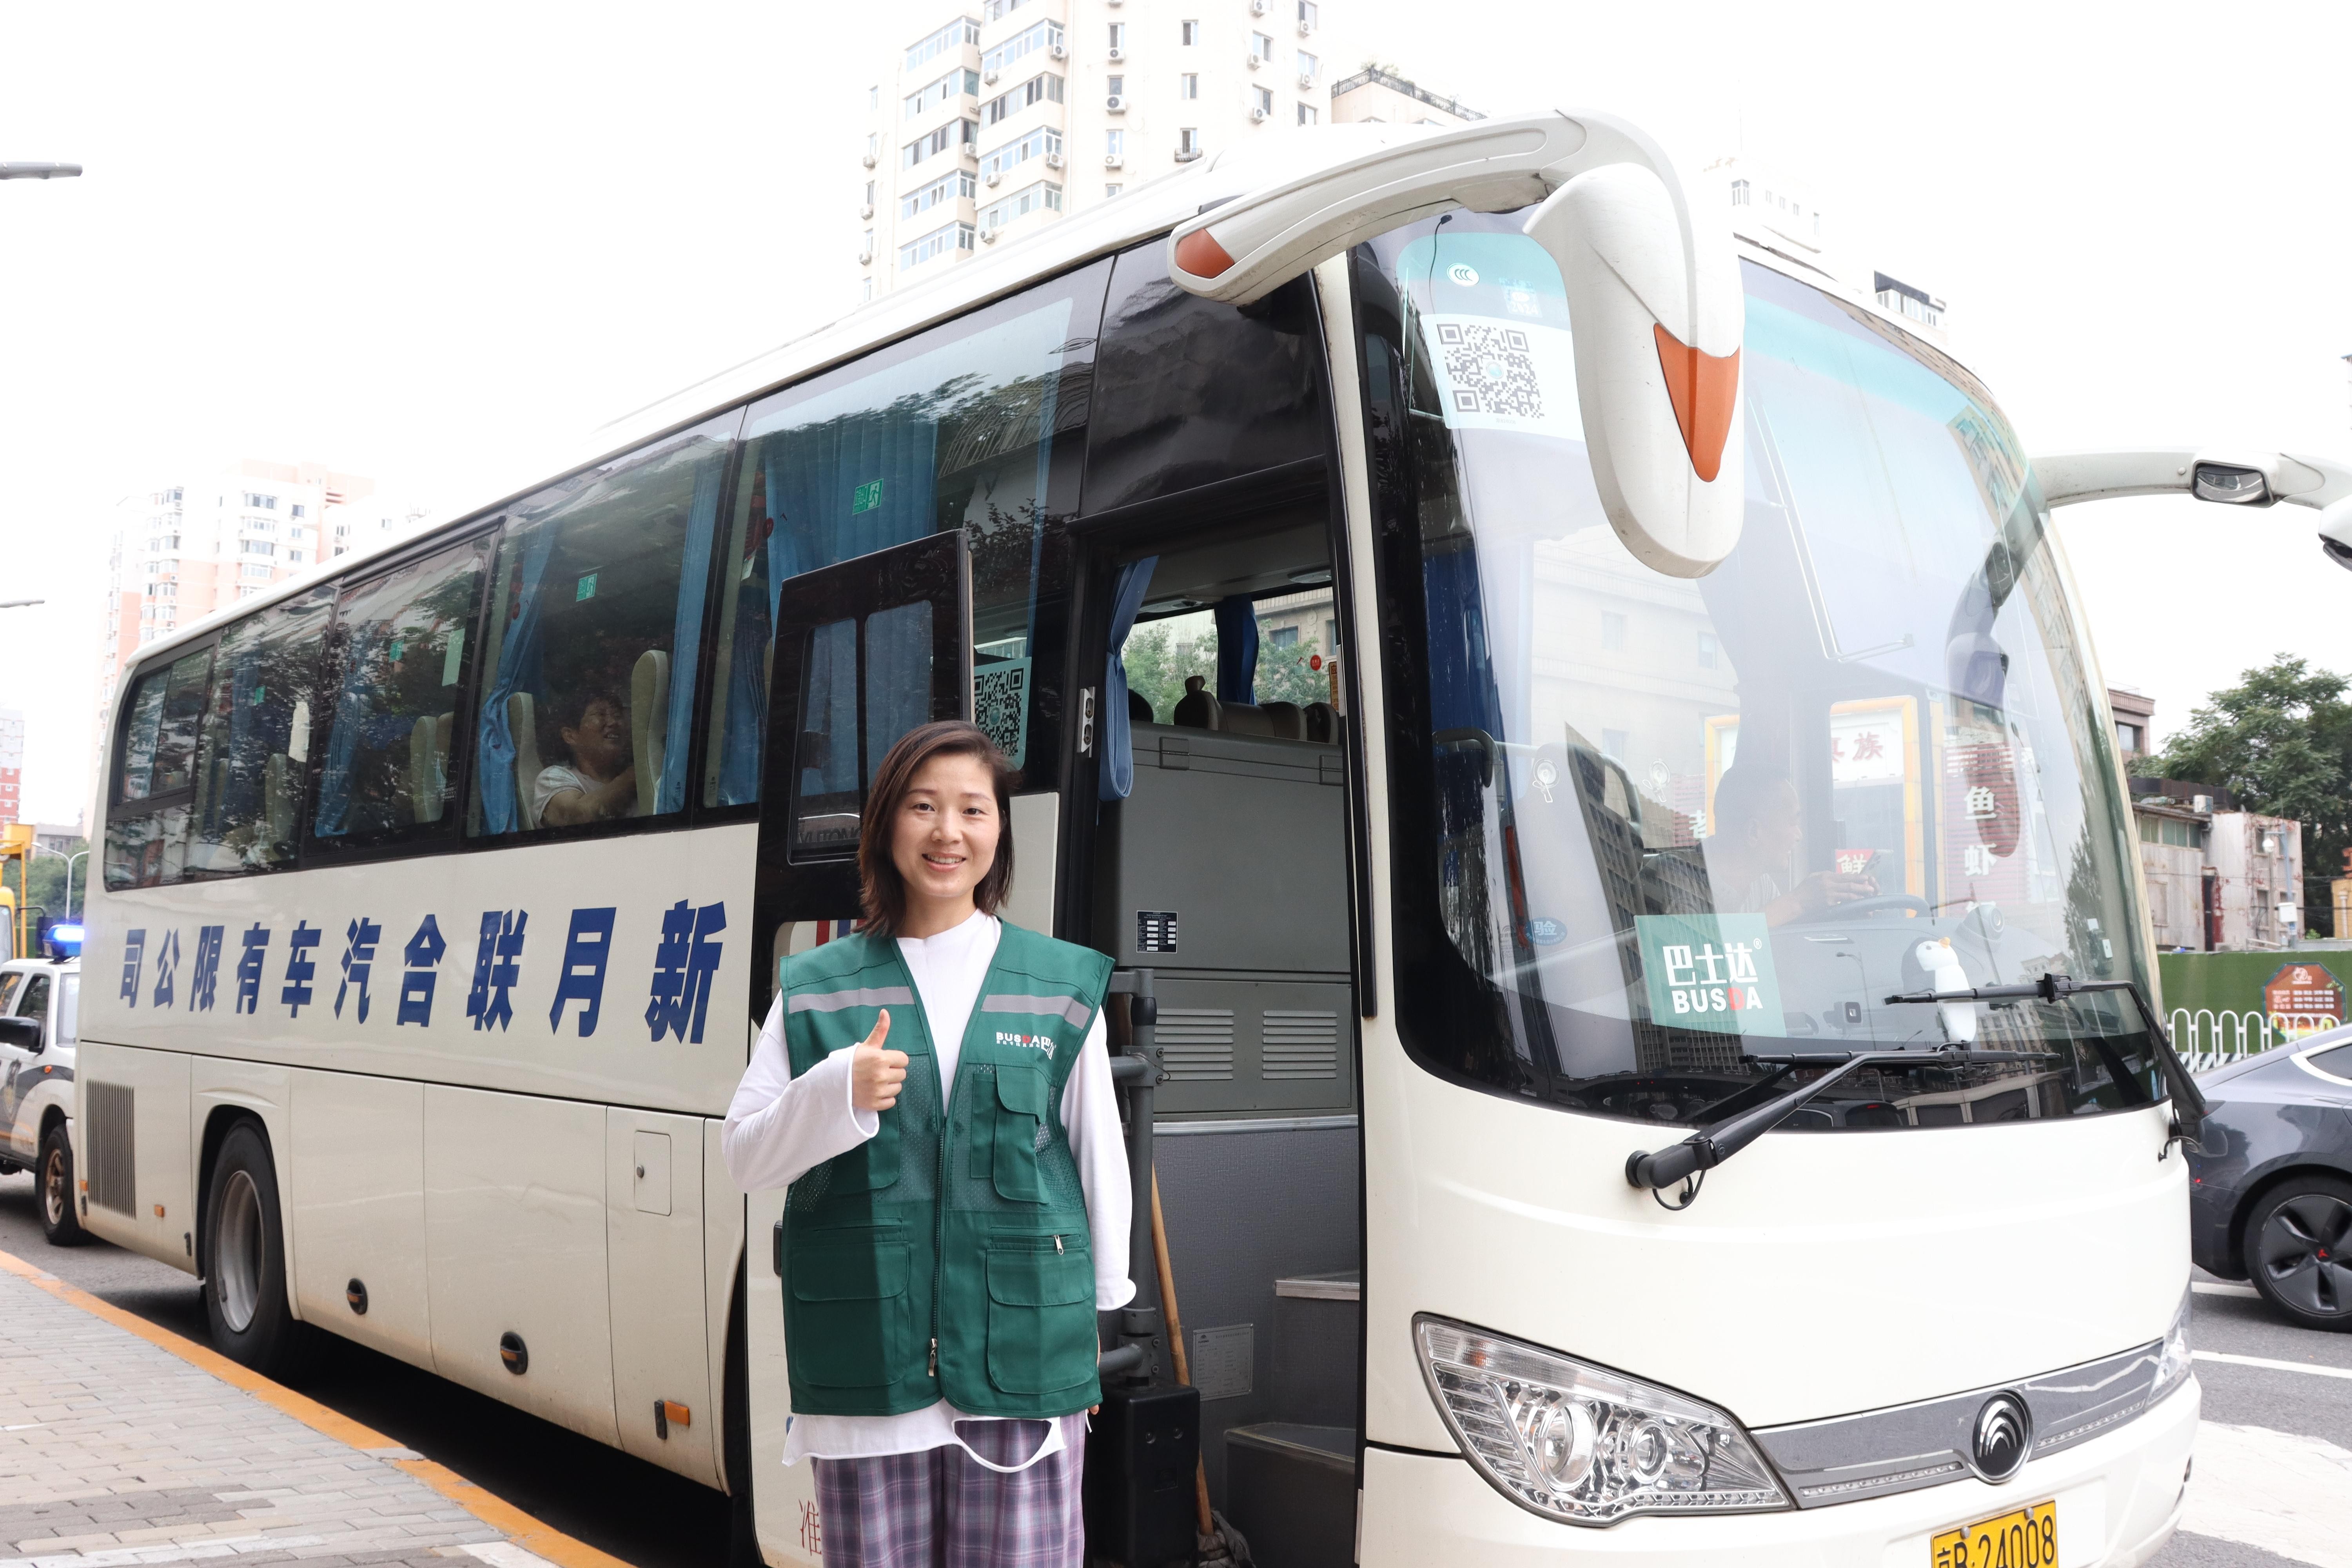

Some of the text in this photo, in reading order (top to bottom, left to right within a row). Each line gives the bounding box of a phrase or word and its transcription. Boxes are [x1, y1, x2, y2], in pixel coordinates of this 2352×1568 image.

[1533, 920, 1557, 936] 验
[1663, 942, 1759, 986] 巴士达
[1671, 986, 1763, 1014] BUSDA
[996, 1032, 1040, 1044] BUSDA
